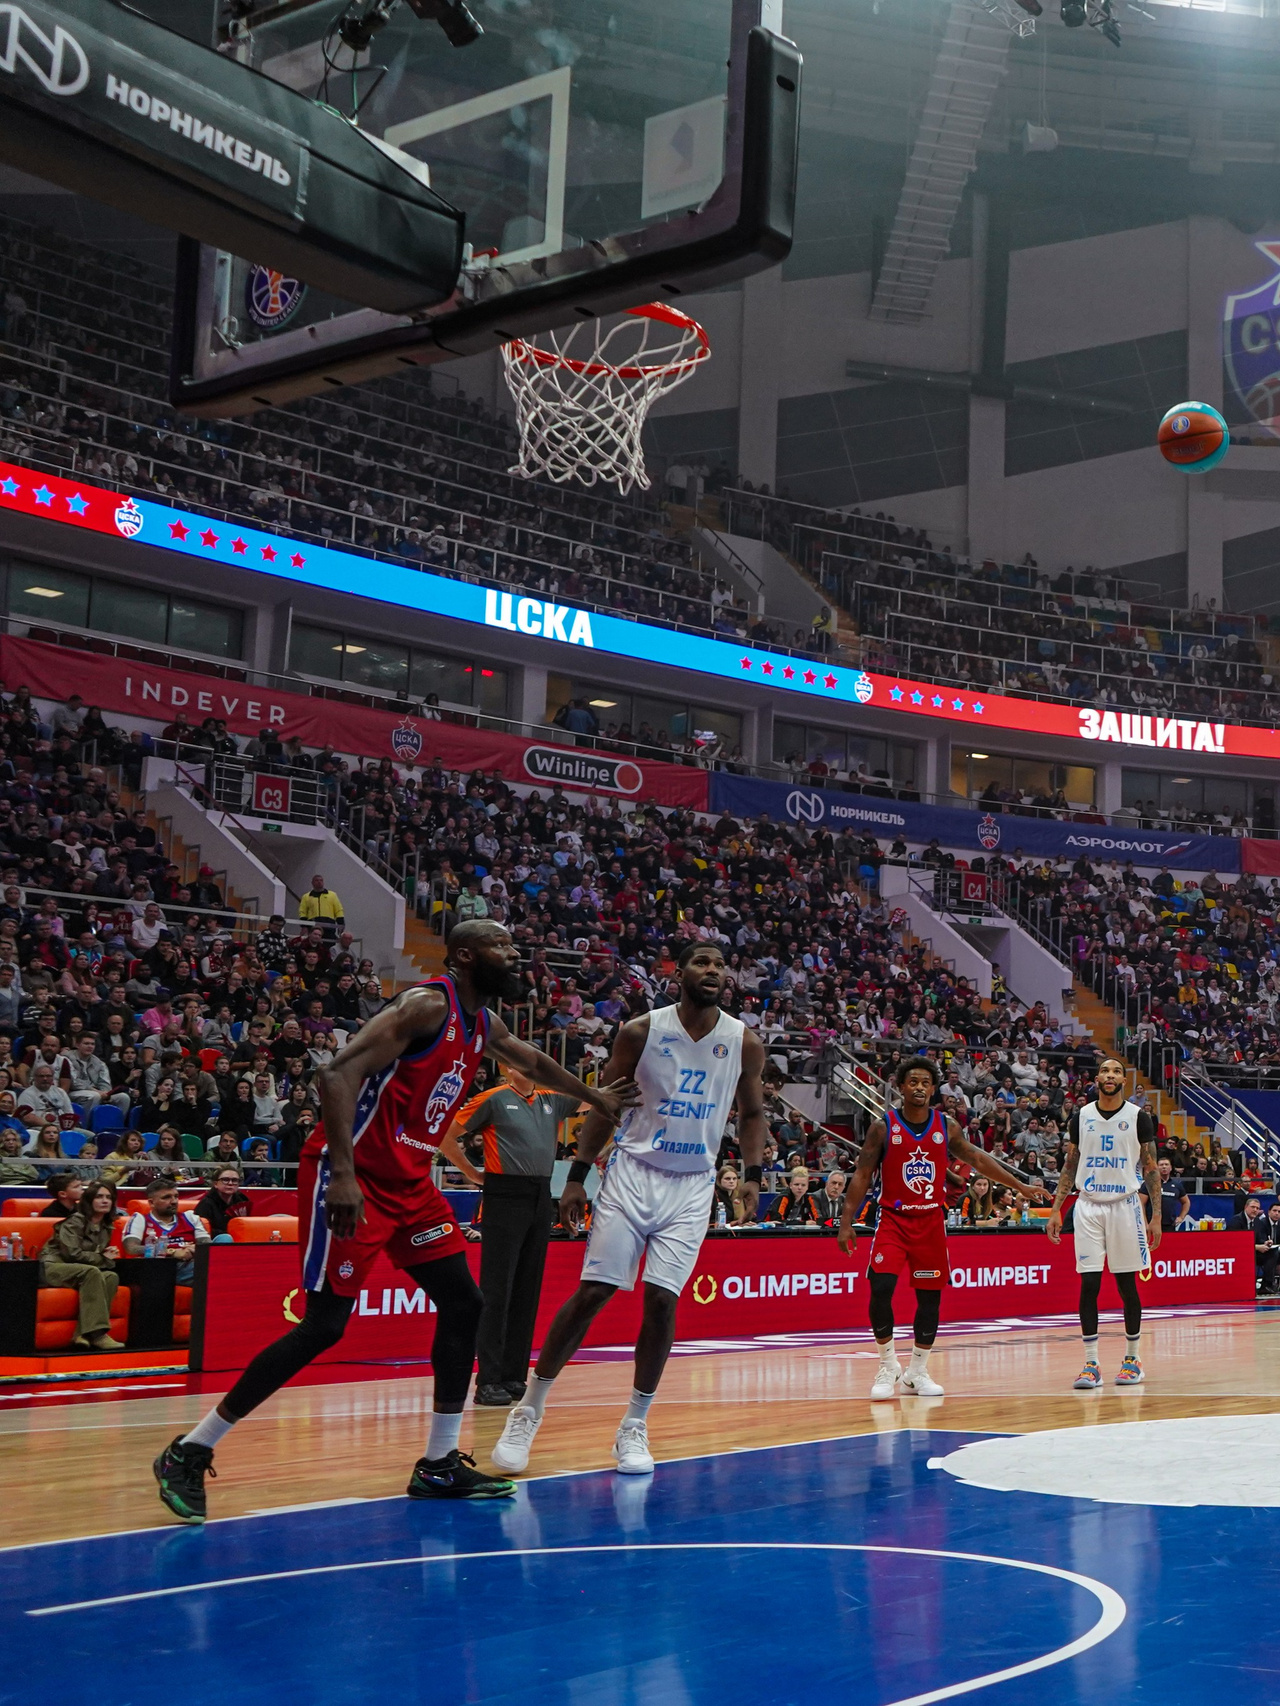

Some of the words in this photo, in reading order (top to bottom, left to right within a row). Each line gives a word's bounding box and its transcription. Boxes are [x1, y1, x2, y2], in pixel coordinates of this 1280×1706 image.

[106, 73, 291, 187] НОРНИКЕЛЬ
[485, 589, 594, 648] ЦСКА
[125, 677, 286, 726] INDEVER
[395, 733, 419, 746] ЦСКА
[1078, 708, 1226, 754] ЗАЩИТА!
[535, 753, 610, 783] Winline
[831, 805, 906, 826] НОРНИКЕЛЬ
[1065, 835, 1164, 854] АЭРОФЛОТ
[437, 1081, 458, 1097] CSKA
[678, 1068, 707, 1095] 22
[657, 1098, 716, 1120] ZENIT
[428, 1112, 445, 1134] 3
[1100, 1135, 1114, 1151] 15
[906, 1166, 931, 1175] CSKA
[1086, 1156, 1127, 1169] ZENIT
[925, 1184, 934, 1200] 2
[1095, 1183, 1126, 1193] ГАЗПРОМ
[415, 1230, 443, 1243] Winline
[950, 1264, 1051, 1288] OLIMPBET
[1154, 1258, 1236, 1278] OLIMPBET
[722, 1271, 859, 1300] OLIMPBET
